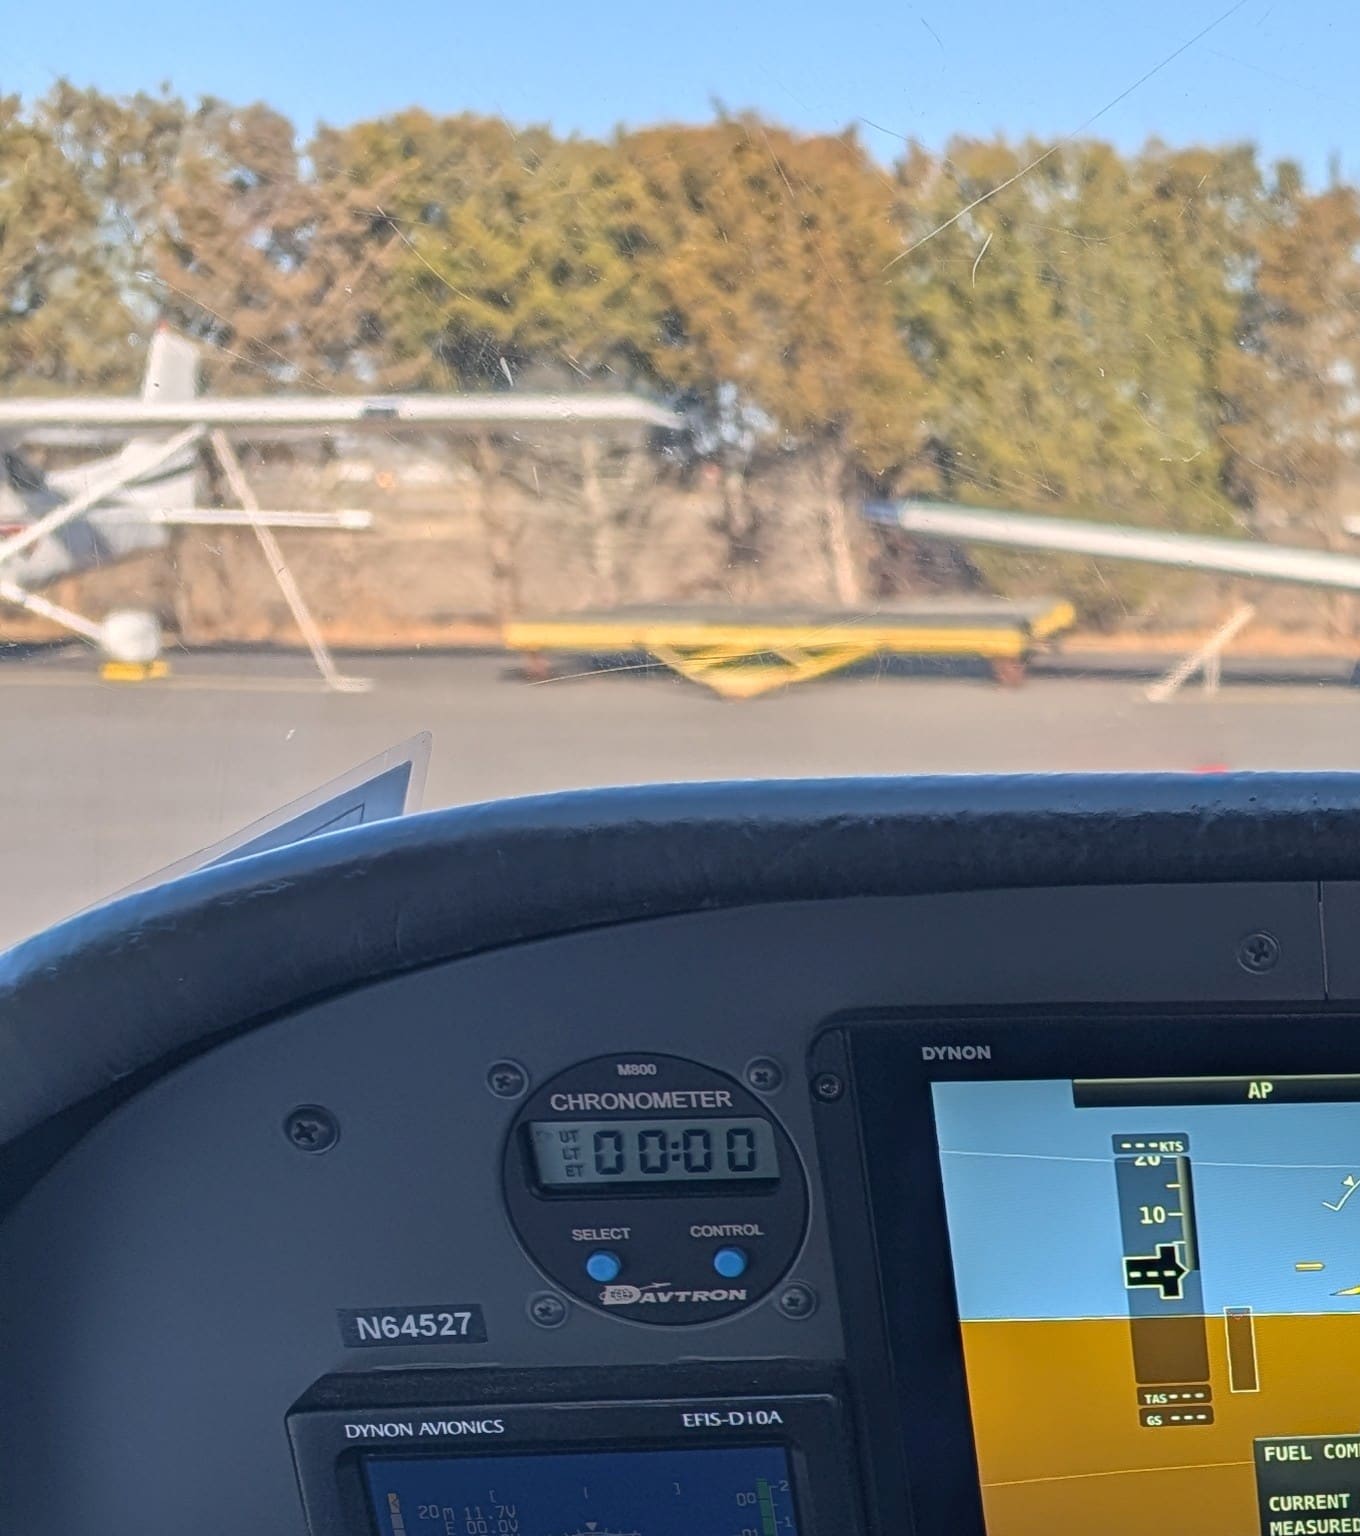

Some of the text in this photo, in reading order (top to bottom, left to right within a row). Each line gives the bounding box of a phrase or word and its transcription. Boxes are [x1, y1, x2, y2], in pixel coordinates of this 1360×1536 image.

[922, 1045, 991, 1060] DYNON
[617, 1064, 657, 1075] M800
[1248, 1082, 1273, 1098] AP
[550, 1091, 732, 1111] CHRONOMETER
[572, 1227, 631, 1241] SELECT
[690, 1224, 764, 1237] CONTROL
[356, 1312, 472, 1340] N64527
[682, 1411, 783, 1426] EFIS-D10A
[344, 1419, 505, 1438] DYNON AVIONICS
[1264, 1444, 1313, 1462] FUEL
[1268, 1494, 1351, 1512] CURRENT
